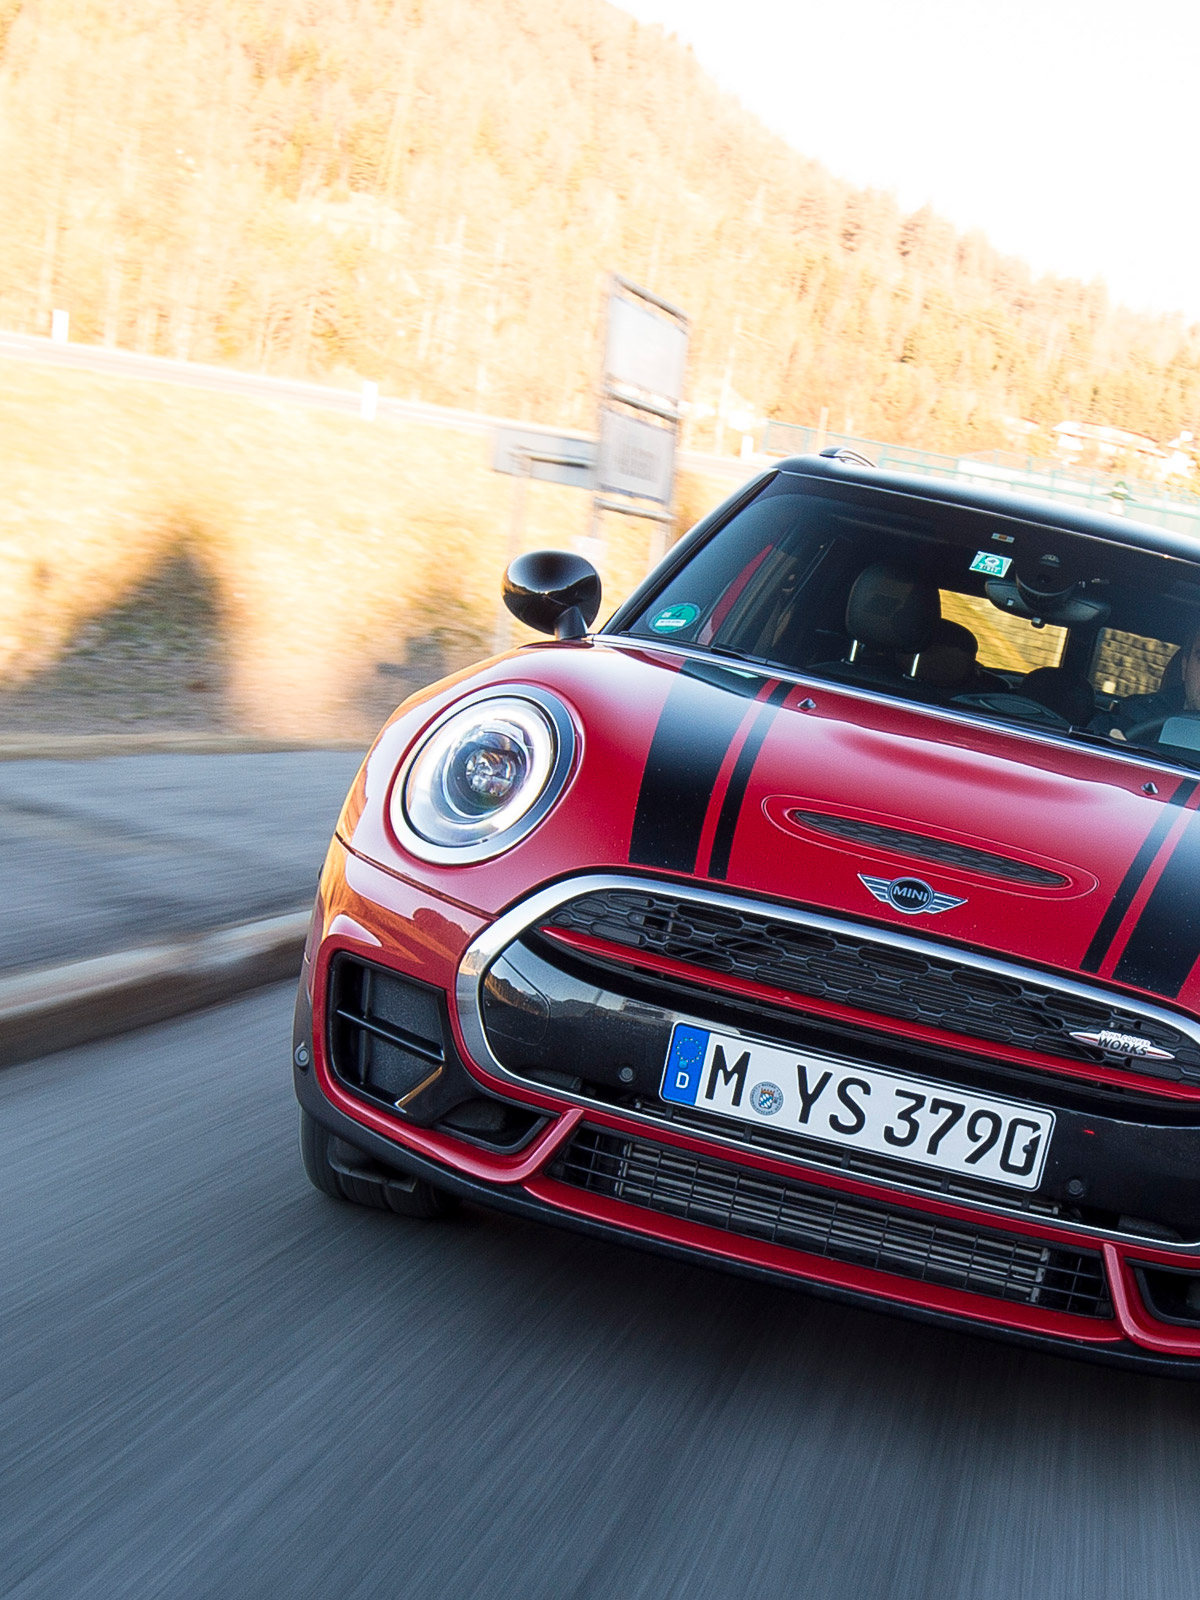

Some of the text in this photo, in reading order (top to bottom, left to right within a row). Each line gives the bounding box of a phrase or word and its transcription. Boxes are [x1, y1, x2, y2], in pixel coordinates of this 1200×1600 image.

[893, 885, 928, 902] MINI
[1098, 1036, 1148, 1056] WORKS
[675, 1072, 690, 1089] D
[705, 1045, 751, 1107] M
[797, 1064, 872, 1135] YS
[883, 1089, 1042, 1177] 3790
